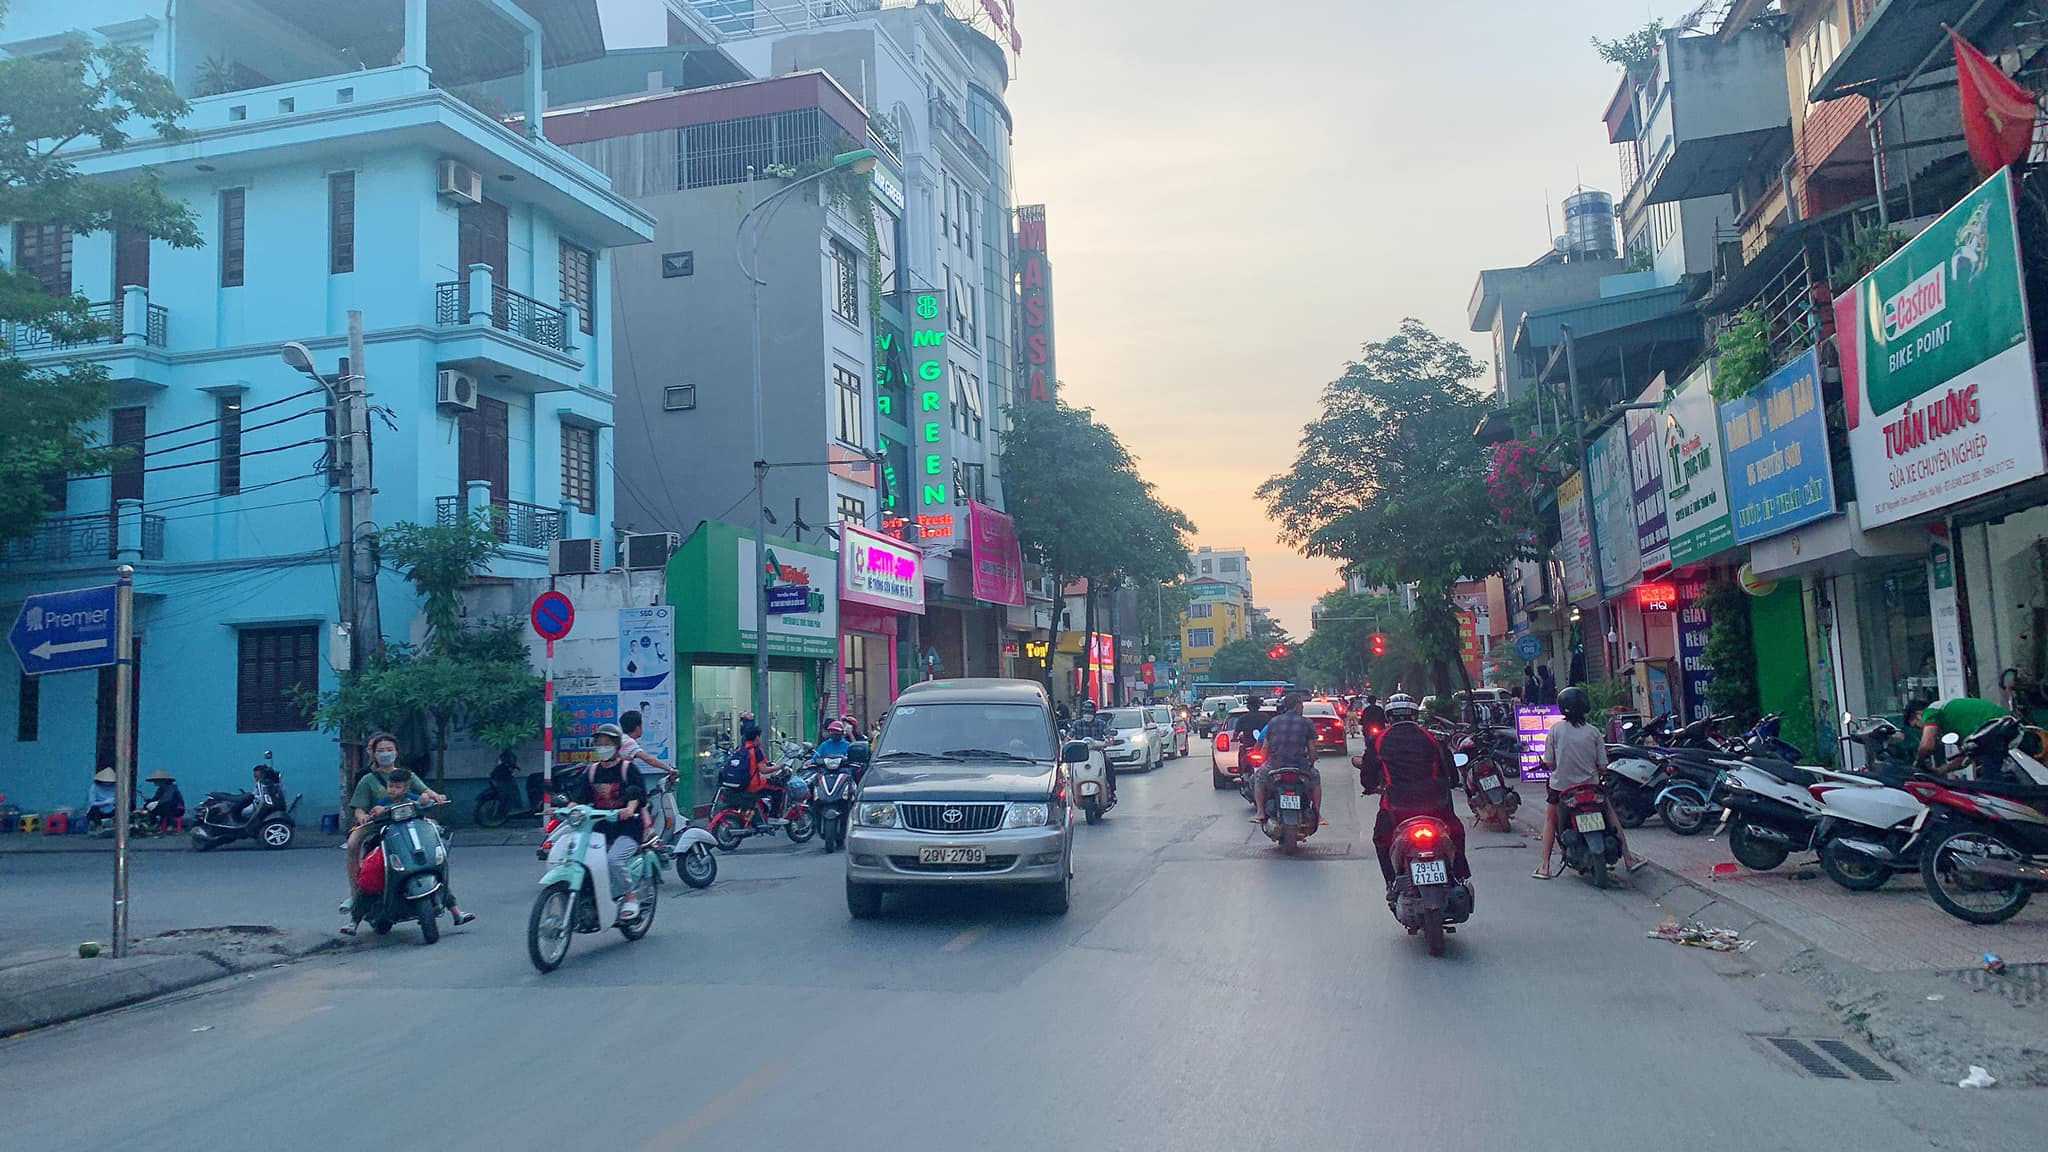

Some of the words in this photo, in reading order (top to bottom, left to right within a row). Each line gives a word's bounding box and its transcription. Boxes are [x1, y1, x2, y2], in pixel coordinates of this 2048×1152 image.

[1896, 271, 1943, 330] Castrol
[912, 330, 945, 348] Mr
[1889, 343, 1913, 374] BIKE
[1916, 320, 1953, 358] POINT
[1882, 401, 1927, 460] TUẤN
[1928, 383, 1981, 441] HƯNG
[918, 360, 946, 506] GREEN
[1906, 463, 1917, 485] XE
[1916, 447, 1951, 480] CHUYÊN
[1952, 432, 1988, 465] NGHIỆP
[917, 513, 954, 525] Fresh
[920, 526, 953, 538] food
[1650, 600, 1668, 611] HQ
[45, 608, 110, 629] Premier
[923, 849, 982, 862] 29V-2799
[1416, 862, 1440, 874] 29-C1
[1415, 871, 1445, 884] 212.68
